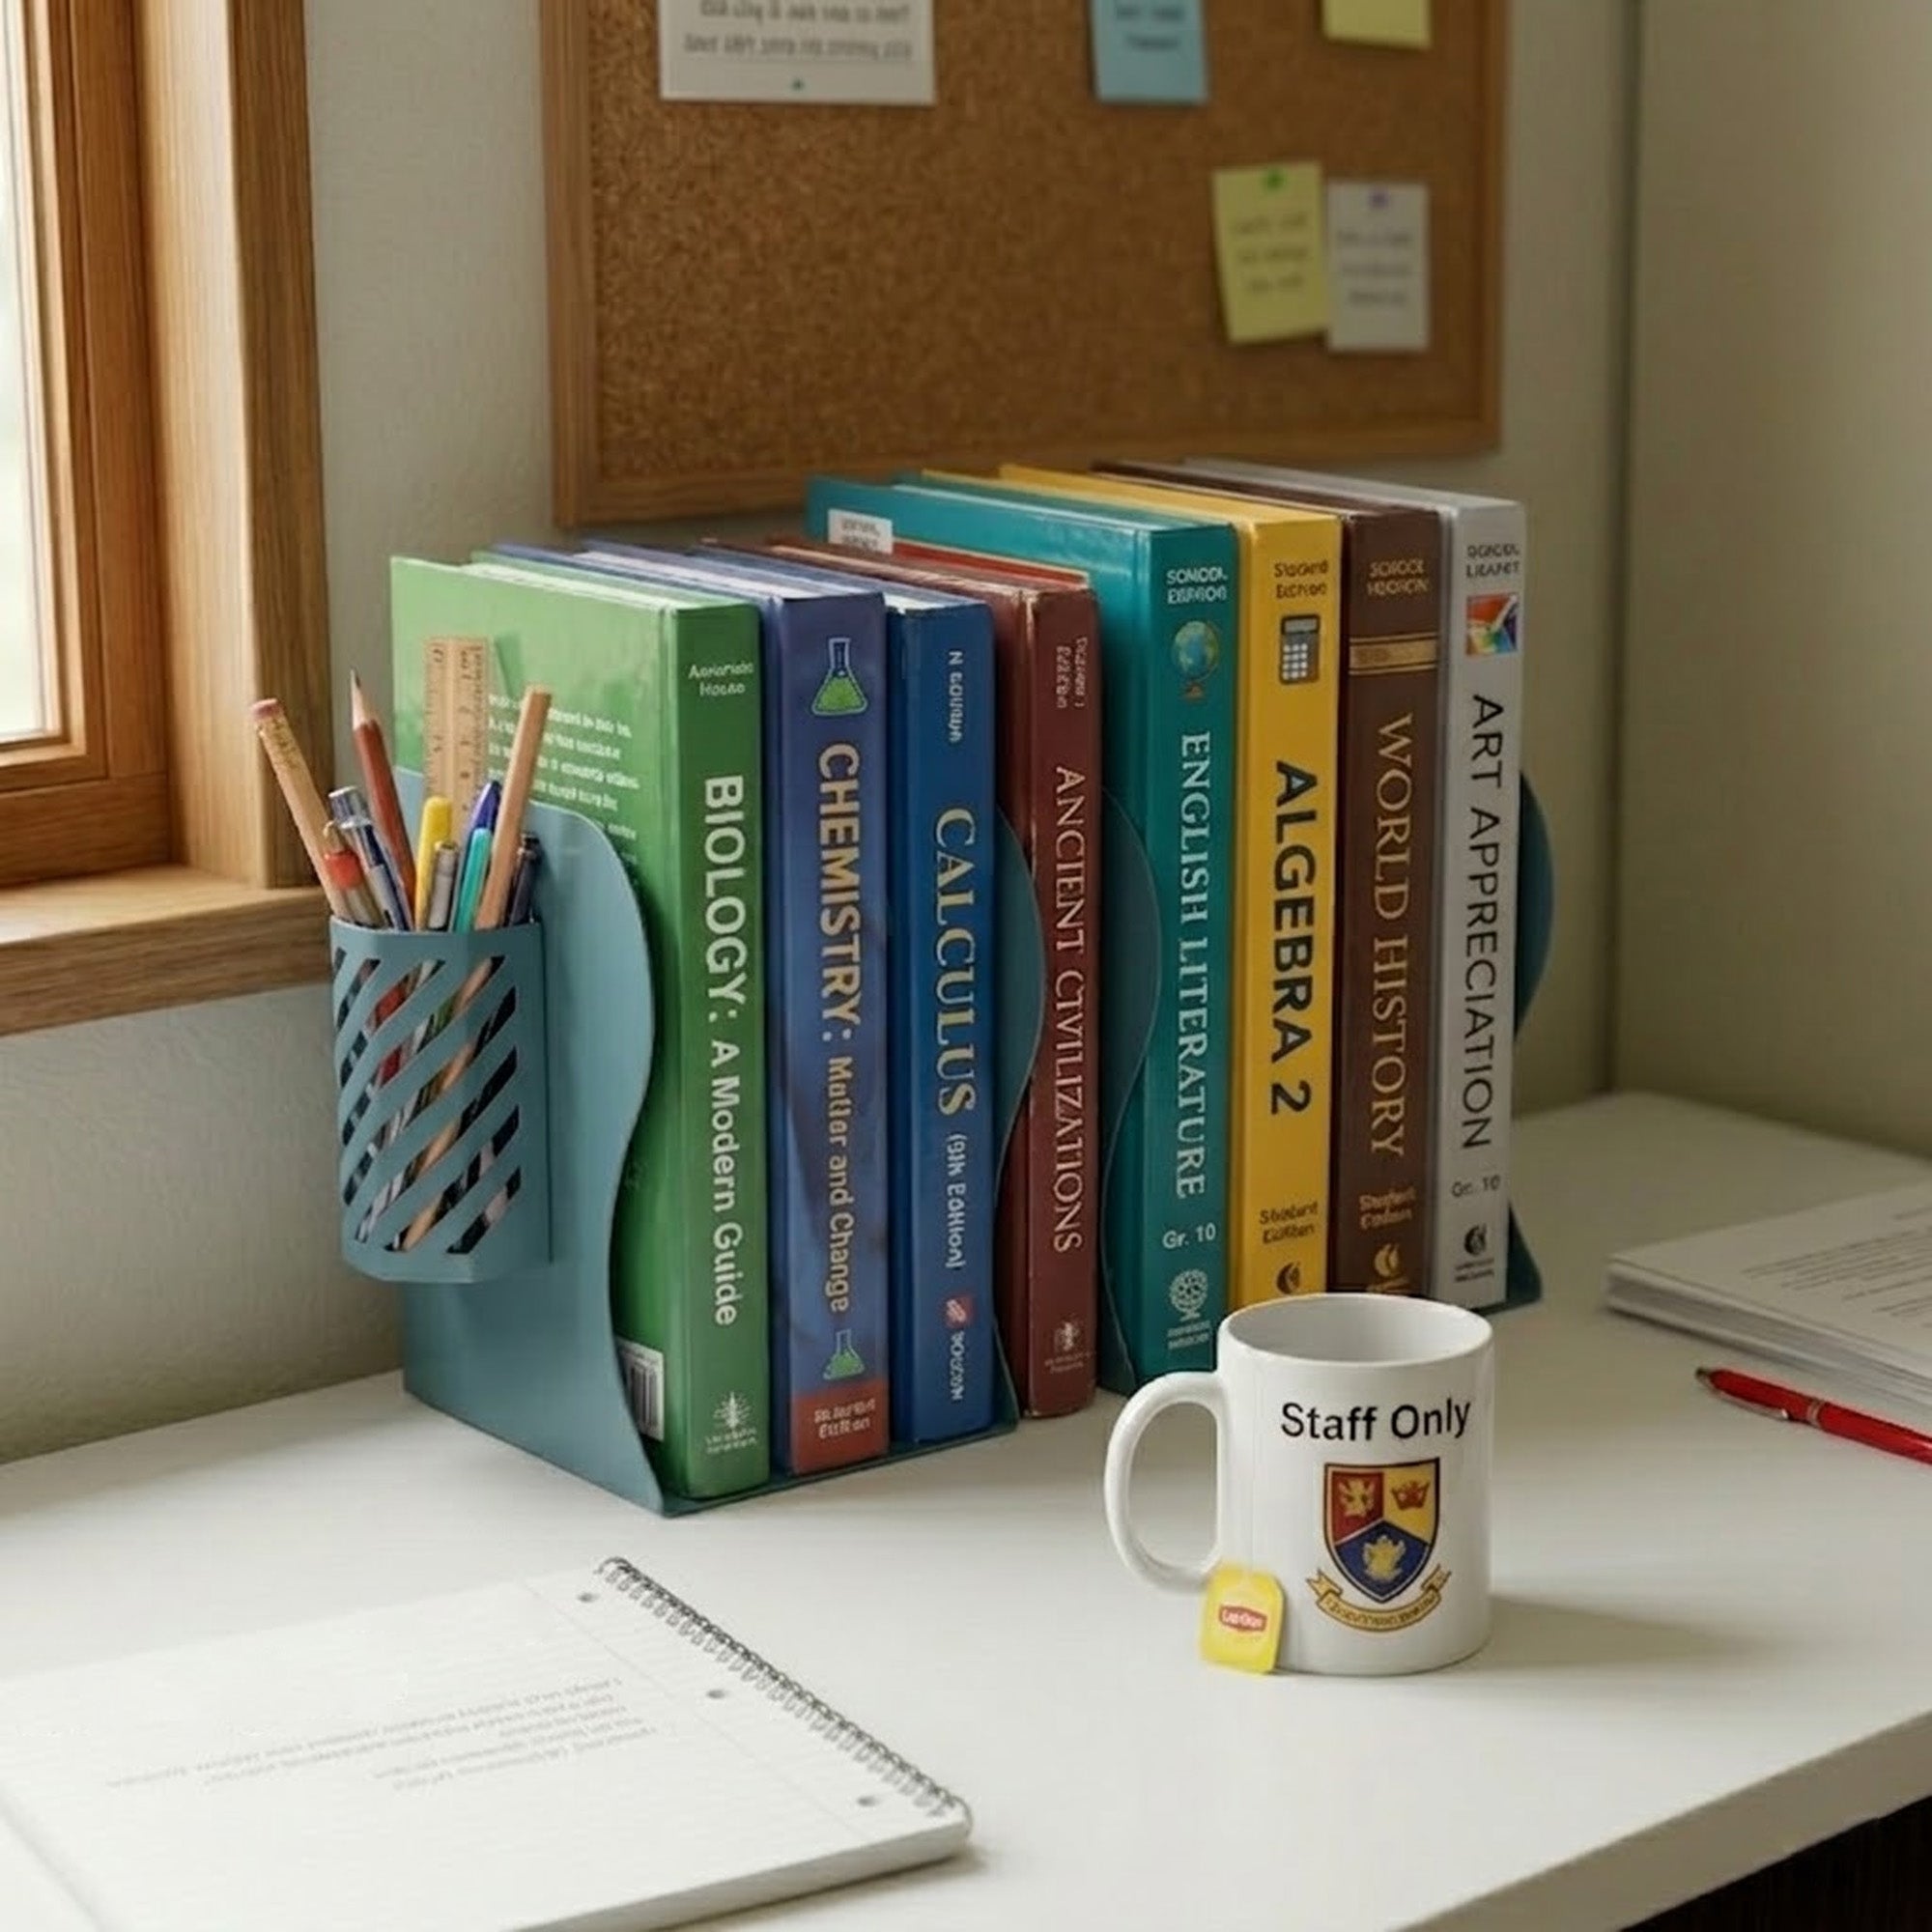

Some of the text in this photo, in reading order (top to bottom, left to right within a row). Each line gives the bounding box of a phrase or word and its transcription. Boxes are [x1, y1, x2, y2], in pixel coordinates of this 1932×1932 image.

[818, 744, 861, 1041] CHEMISTRY:
[936, 808, 977, 1118] CALCULUS
[1177, 732, 1209, 1198] ENGLISH LITERATURE
[1270, 761, 1318, 1116] ALGEBRA 2
[1376, 715, 1412, 921] WORLD
[1462, 695, 1504, 1150] ART APPRECIATION
[705, 776, 747, 1326] BIOLOGY: A Modern Guide
[1053, 766, 1086, 1254] ANCIENT CIVILIZATIONS
[1371, 938, 1406, 1155] HISTORY
[825, 1211, 856, 1313] Change
[829, 1155, 854, 1204] and
[1162, 1222, 1216, 1249] Gr. 10
[1281, 1398, 1471, 1440] Staff Only
